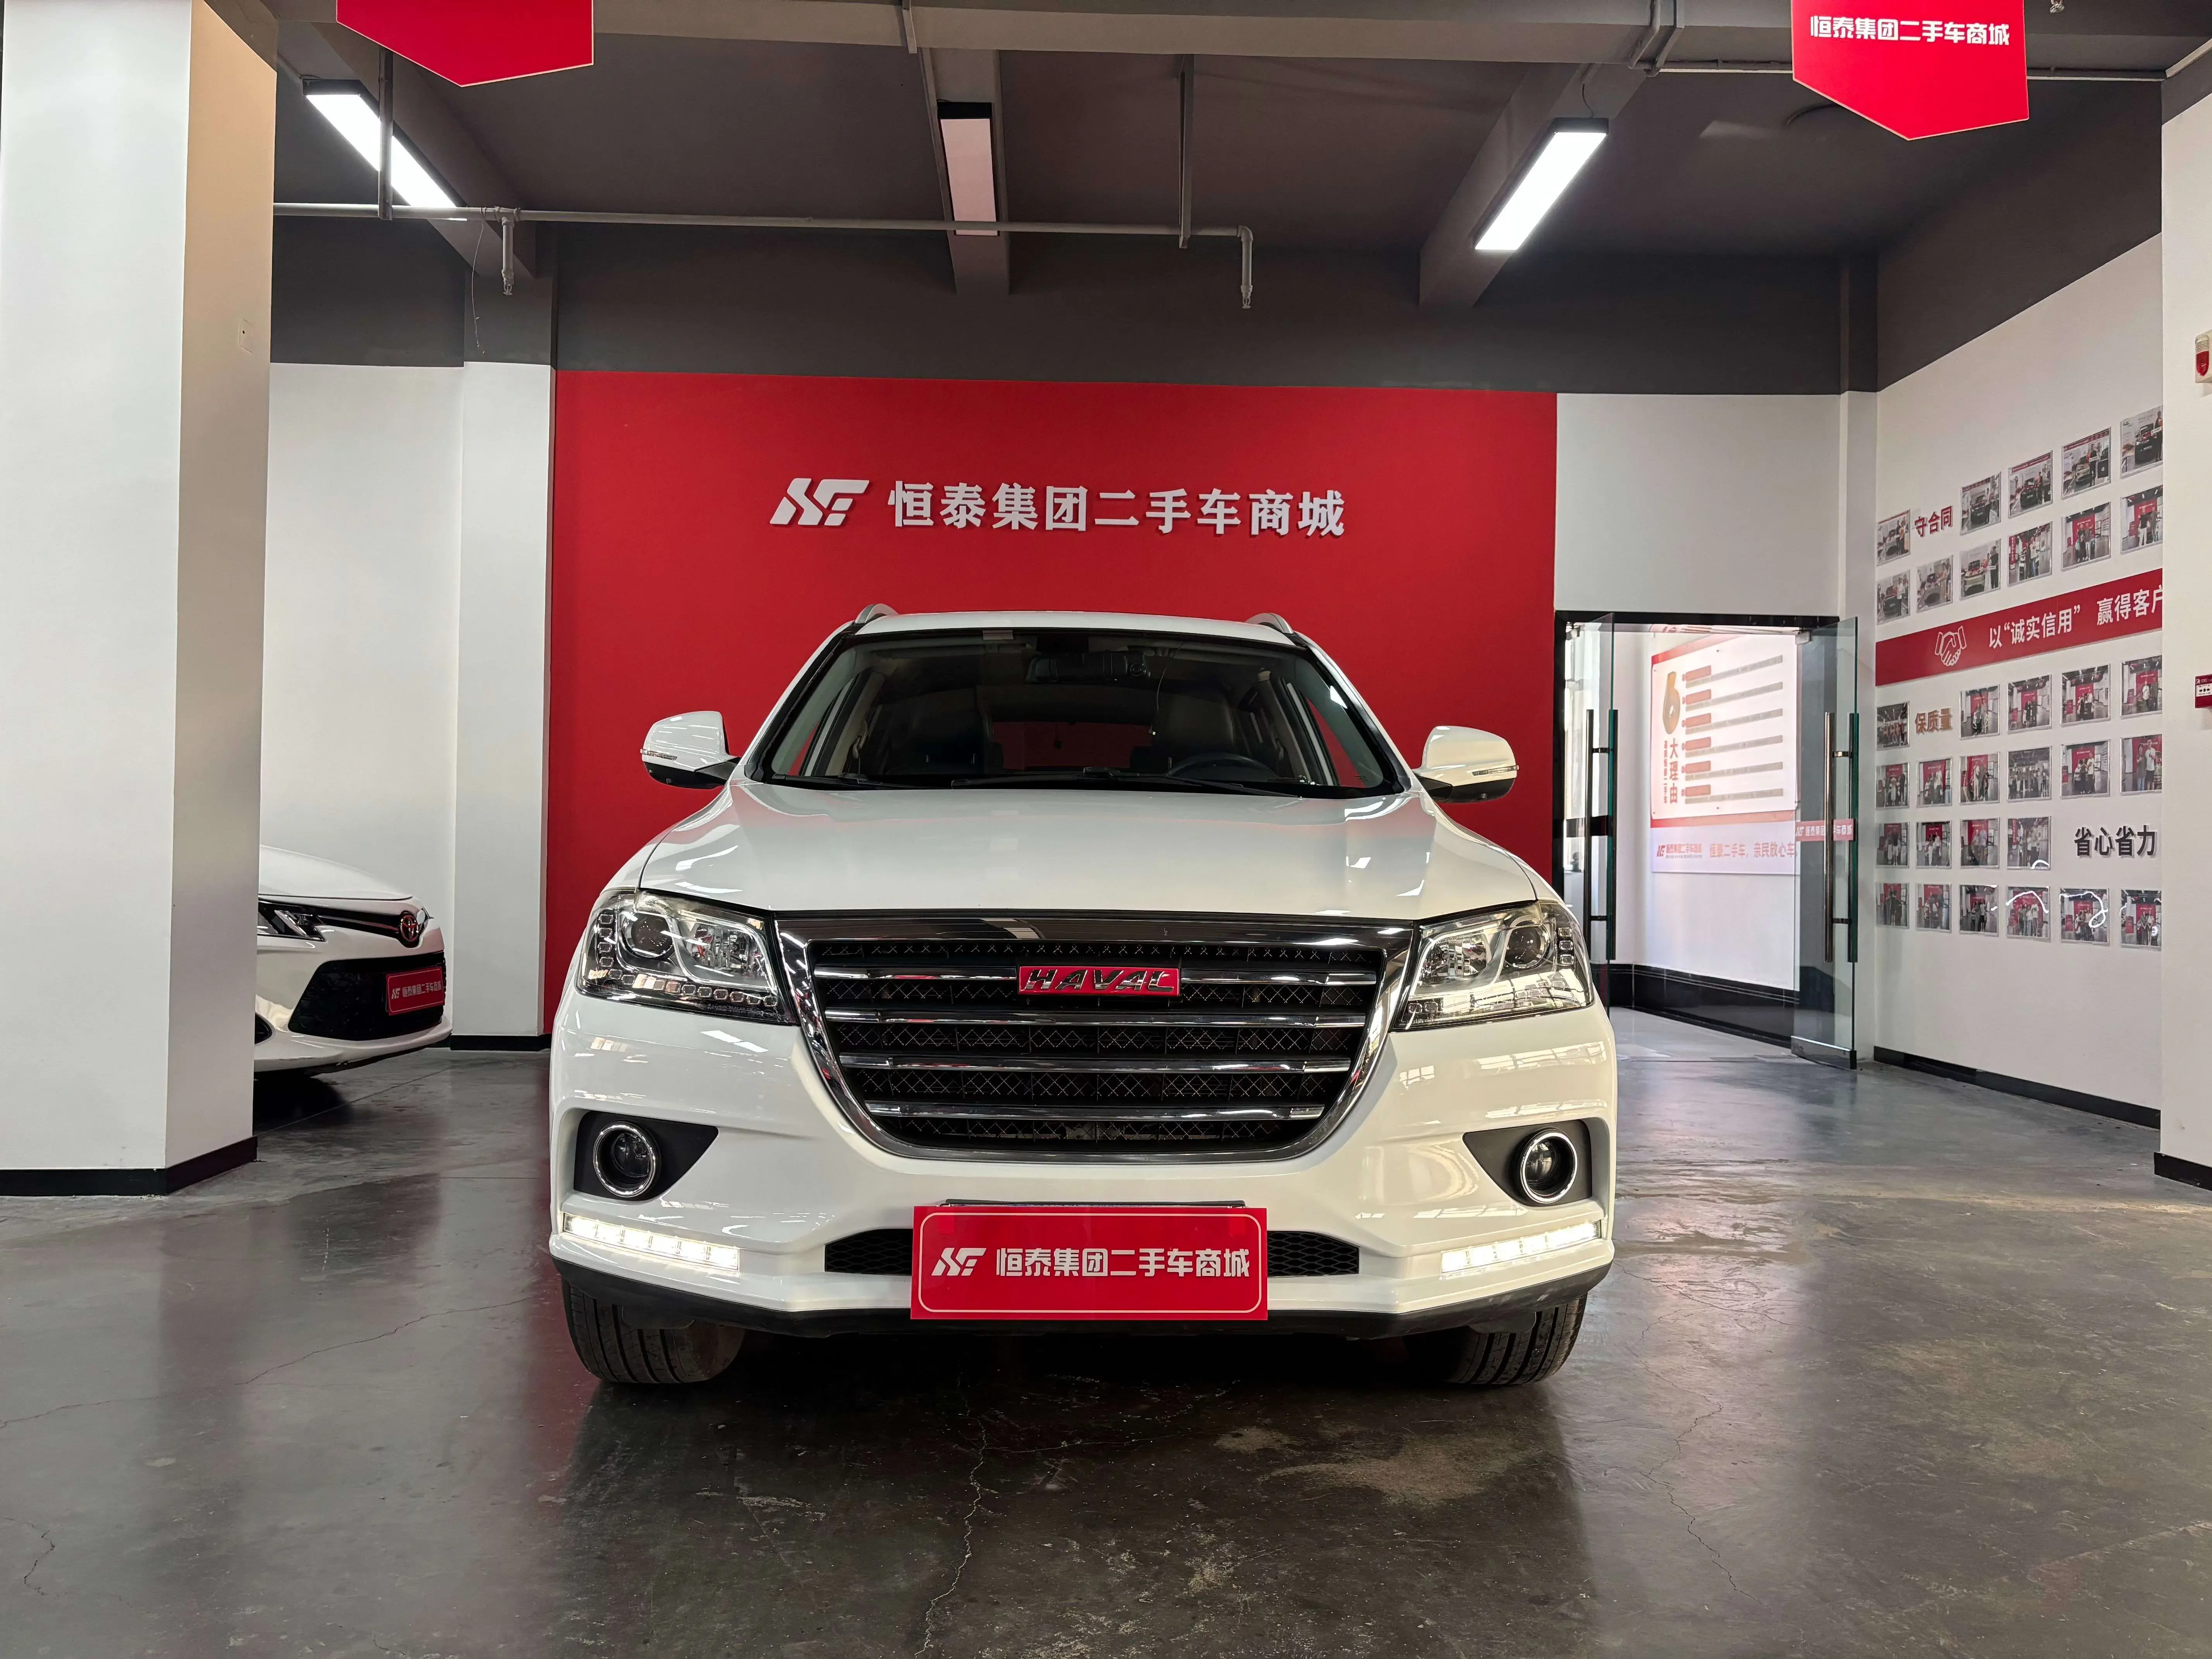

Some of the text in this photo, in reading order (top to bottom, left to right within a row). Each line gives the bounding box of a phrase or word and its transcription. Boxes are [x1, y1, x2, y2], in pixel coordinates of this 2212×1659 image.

[1810, 15, 2010, 46] 恒泰集团二手车商城
[888, 481, 1345, 537] 恒泰集团二手车商城
[1915, 505, 1953, 538] 守合同
[2097, 584, 2162, 625] 赢得客户
[1915, 708, 1952, 734] 保质量
[2074, 825, 2155, 856] 省心省力
[1024, 969, 1174, 991] HAVAL
[996, 1248, 1250, 1278] 恒泰集团二手车商城
